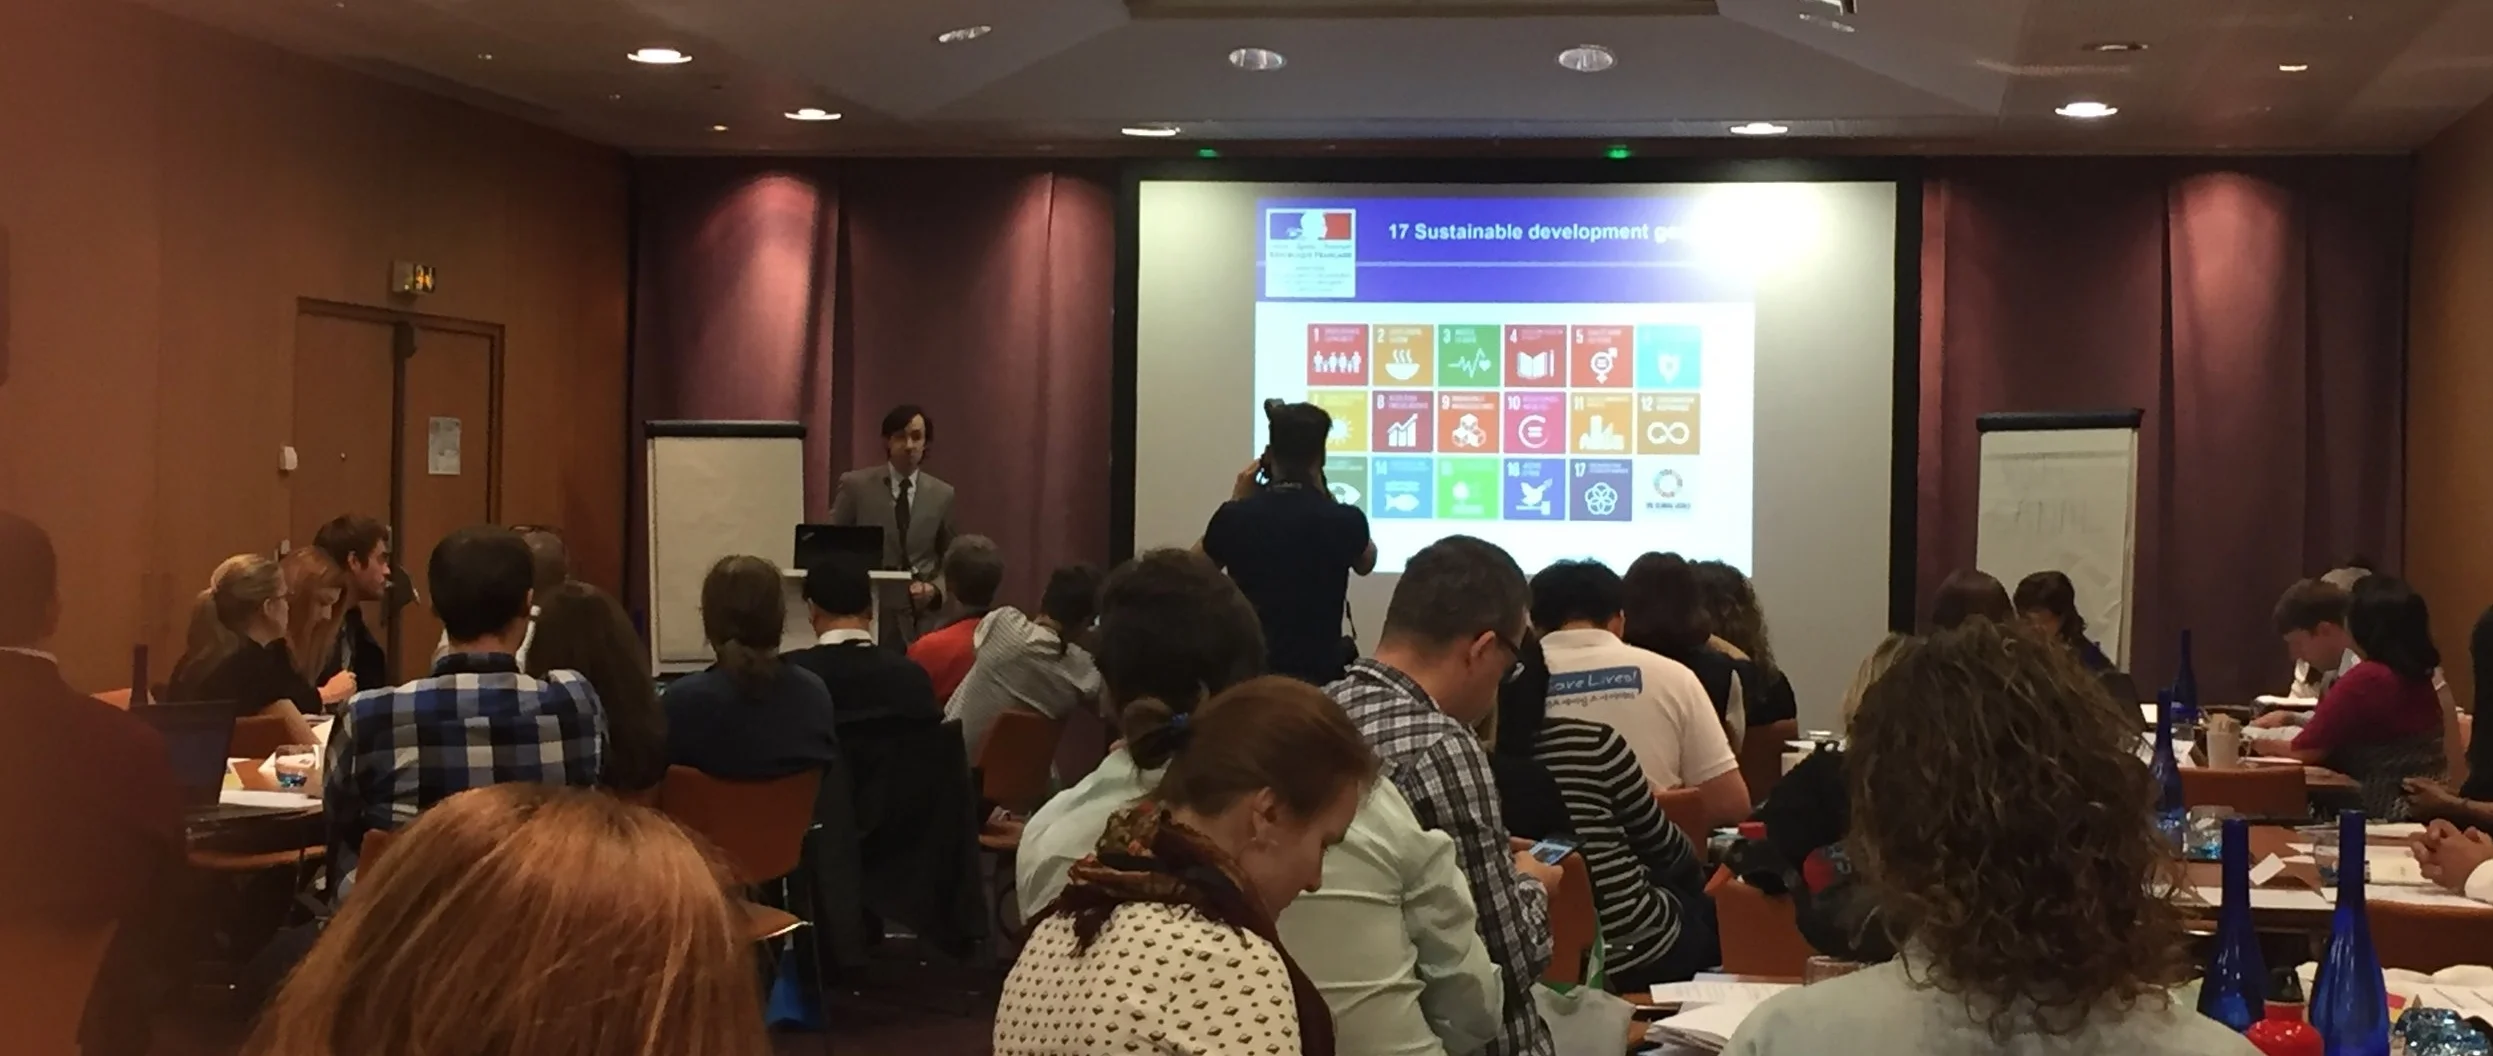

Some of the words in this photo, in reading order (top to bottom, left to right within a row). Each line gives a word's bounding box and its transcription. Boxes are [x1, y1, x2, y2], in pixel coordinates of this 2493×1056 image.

[1388, 223, 1409, 240] 17
[1414, 222, 1523, 241] Sustainable
[1528, 222, 1649, 243] development
[1377, 328, 1385, 343] 2
[1443, 328, 1451, 344] 3
[1509, 328, 1518, 343] 4
[1576, 329, 1584, 344] 5
[1507, 395, 1521, 410] 10
[1574, 462, 1586, 477] 17
